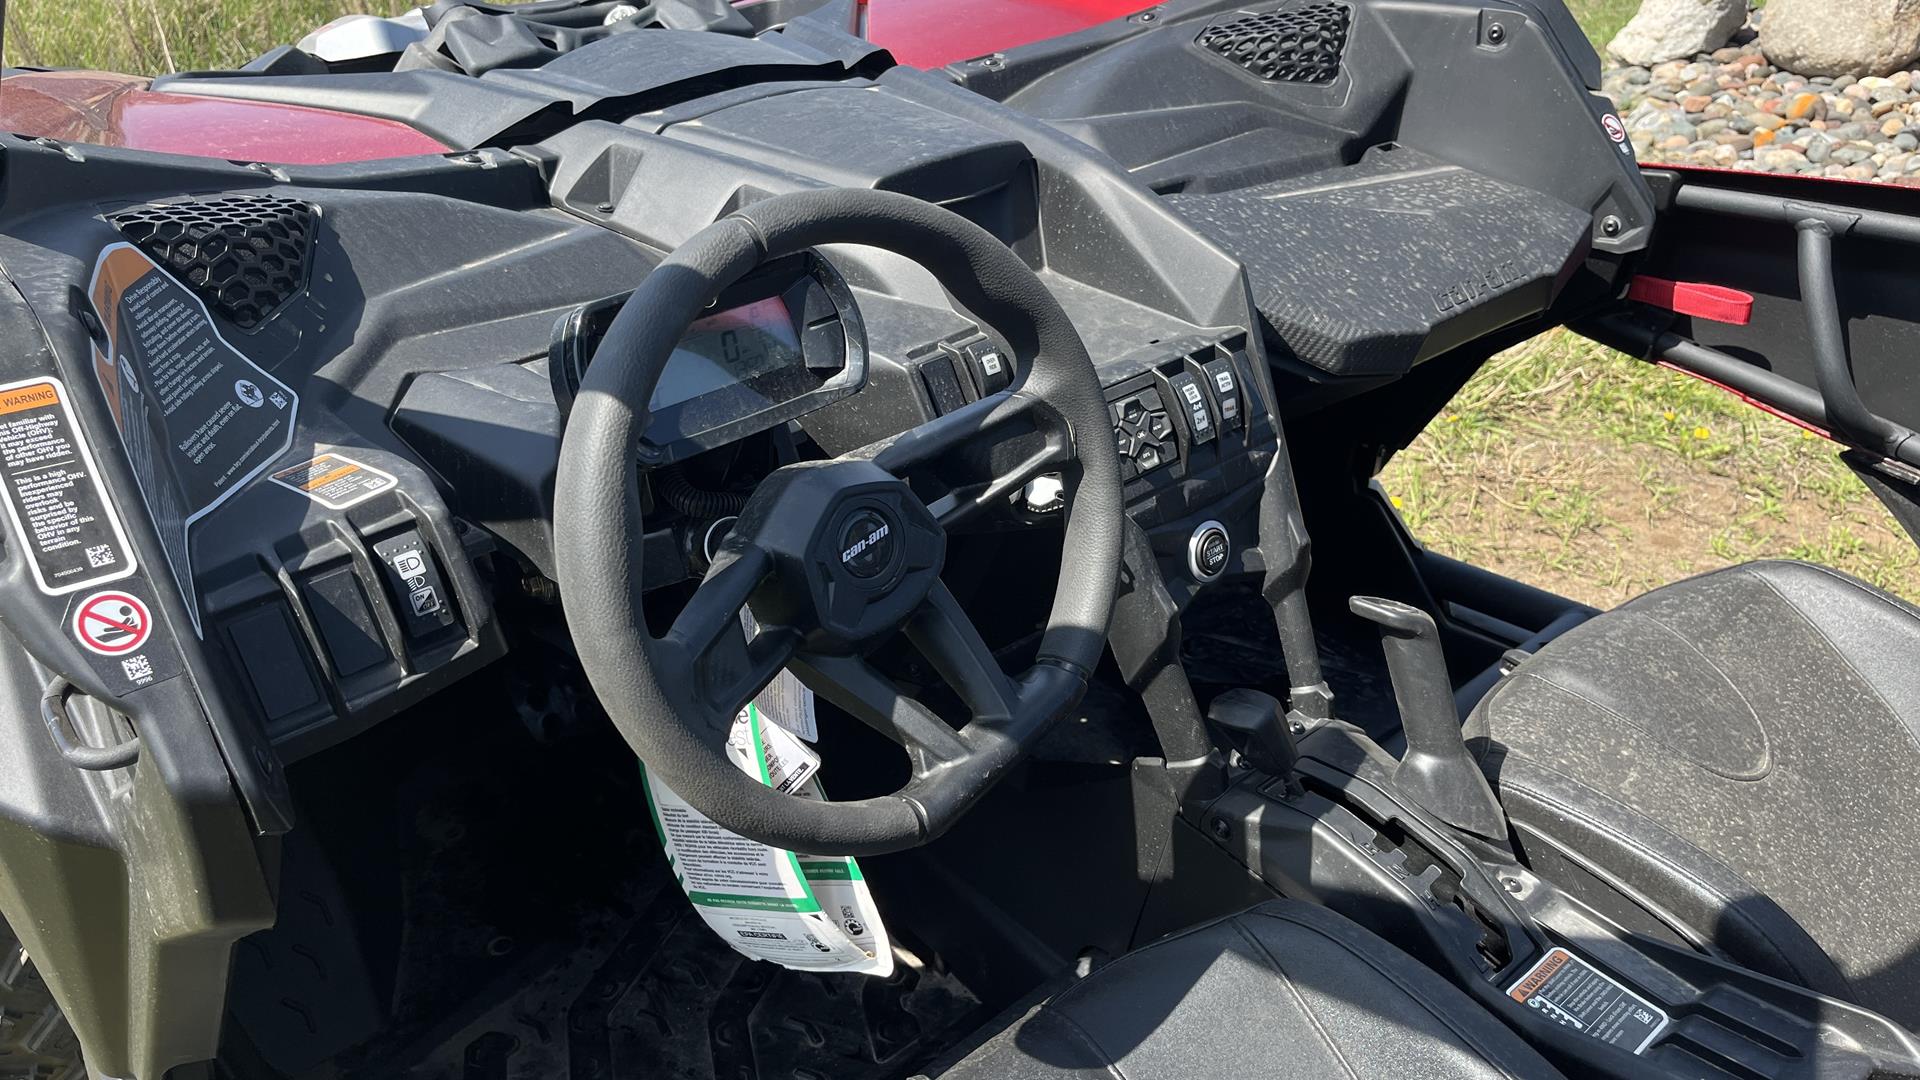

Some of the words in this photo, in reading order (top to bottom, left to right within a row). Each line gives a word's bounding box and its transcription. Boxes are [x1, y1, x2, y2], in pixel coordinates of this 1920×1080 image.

[721, 330, 740, 363] 0
[3, 389, 54, 406] WARNING
[7, 416, 37, 427] familiar
[36, 413, 55, 421] with
[10, 418, 59, 434] Off-Highway
[1, 447, 16, 455] the
[15, 437, 65, 452] performance
[6, 439, 25, 448] may
[23, 432, 53, 443] exceed
[6, 459, 25, 468] may
[24, 454, 45, 463] have
[44, 448, 72, 458] ridden.
[13, 449, 35, 459] other
[35, 445, 55, 454] OHV
[54, 443, 71, 452] you
[14, 476, 33, 485] This
[47, 468, 67, 478] high
[16, 476, 67, 491] performance
[66, 470, 87, 480] OHV.
[18, 480, 75, 497] Inexperienced
[21, 493, 45, 503] riders
[45, 490, 64, 499] may
[23, 496, 59, 509] overlook
[26, 506, 47, 515] risks
[46, 502, 64, 511] and
[63, 499, 75, 507] be
[28, 507, 68, 522] surprised
[66, 505, 79, 514] by
[31, 520, 46, 528] the
[45, 512, 78, 525] specific
[33, 521, 70, 534] behavior
[78, 514, 95, 523] this
[36, 530, 56, 540] OHV
[64, 525, 81, 534] any
[38, 534, 66, 546] terrain
[41, 537, 82, 552] condition.
[842, 524, 889, 562] can-am
[1207, 543, 1223, 557] START
[1209, 553, 1224, 566] STOP
[415, 594, 425, 602] ON
[1522, 955, 1563, 991] WARNING
